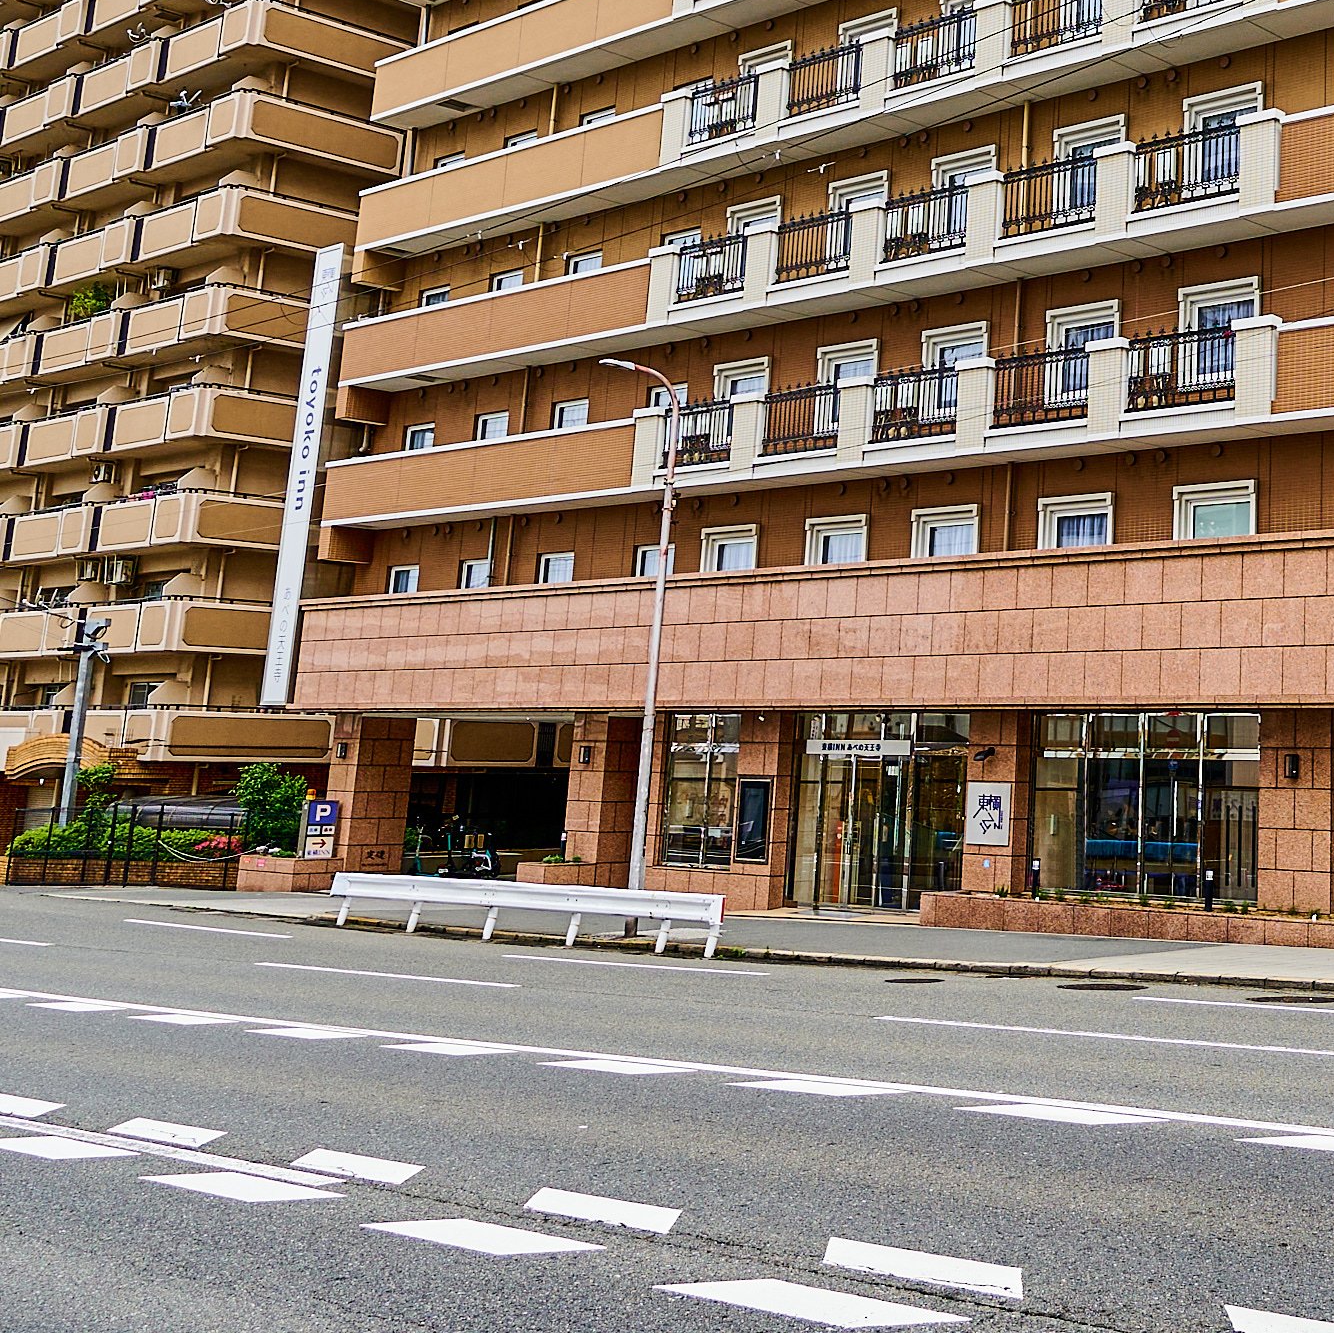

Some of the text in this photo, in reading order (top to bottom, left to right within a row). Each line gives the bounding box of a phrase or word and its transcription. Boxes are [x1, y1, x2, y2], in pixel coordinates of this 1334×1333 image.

[295, 366, 322, 511] toyoko inn
[315, 804, 332, 822] P
